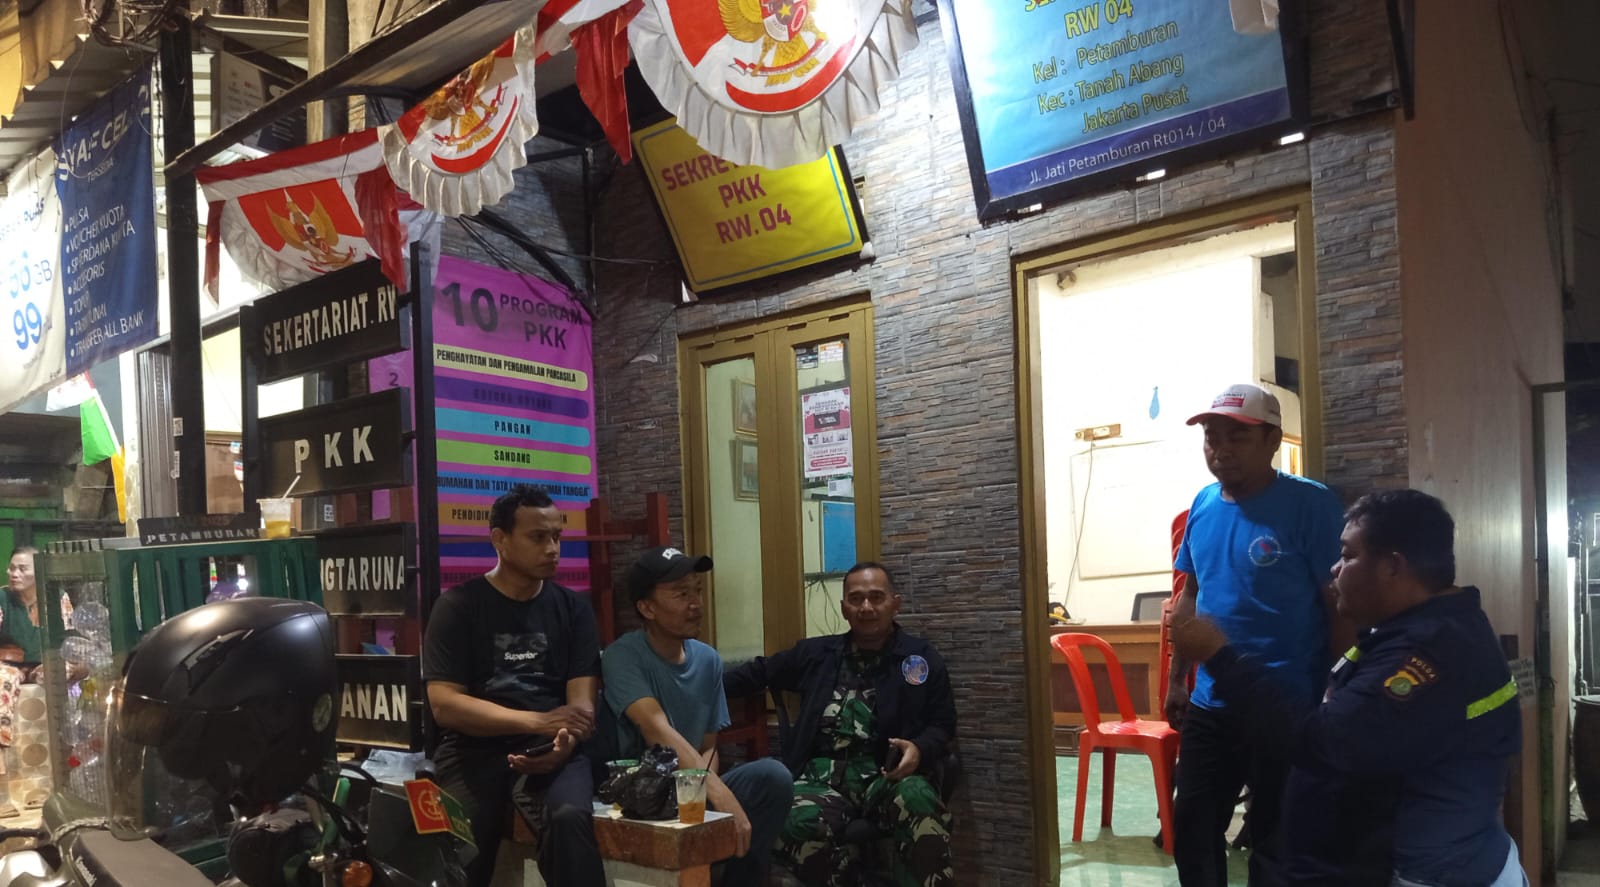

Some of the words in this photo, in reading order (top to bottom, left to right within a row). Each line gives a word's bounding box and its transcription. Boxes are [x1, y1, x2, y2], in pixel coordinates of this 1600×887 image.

[1063, 2, 1099, 39] RW
[1104, 0, 1134, 24] 04
[1076, 20, 1179, 69] Petamburan
[1075, 69, 1125, 102] Tanah
[1129, 54, 1185, 86] Abang
[1082, 101, 1140, 134] Jakarta
[1142, 84, 1189, 115] Pusat
[102, 110, 128, 150] CEL
[661, 154, 739, 191] SEKRE
[1029, 170, 1041, 185] Jl.
[1045, 161, 1065, 180] Jati
[1069, 138, 1150, 172] Petamburan
[1153, 125, 1195, 147] Rt014
[718, 173, 766, 208] PKK
[70, 205, 89, 232] PUSA
[70, 220, 100, 252] VOCHER
[104, 320, 119, 338] ALL
[120, 309, 144, 334] BANK
[441, 282, 498, 332] 10
[500, 294, 583, 325] PROGRAM
[13, 302, 43, 350] 99
[523, 320, 567, 350] PKK
[437, 349, 487, 367] PENGHAYATAN
[488, 357, 502, 369] DAN
[503, 360, 545, 377] PENGAMALAN
[546, 368, 577, 382] PANCASILA
[494, 420, 531, 435] PANGAN
[294, 425, 375, 474] PKK
[494, 450, 531, 464] SANDANG
[475, 478, 490, 491] DAN
[492, 480, 508, 491] TATA
[452, 508, 490, 524] PENDIDIK
